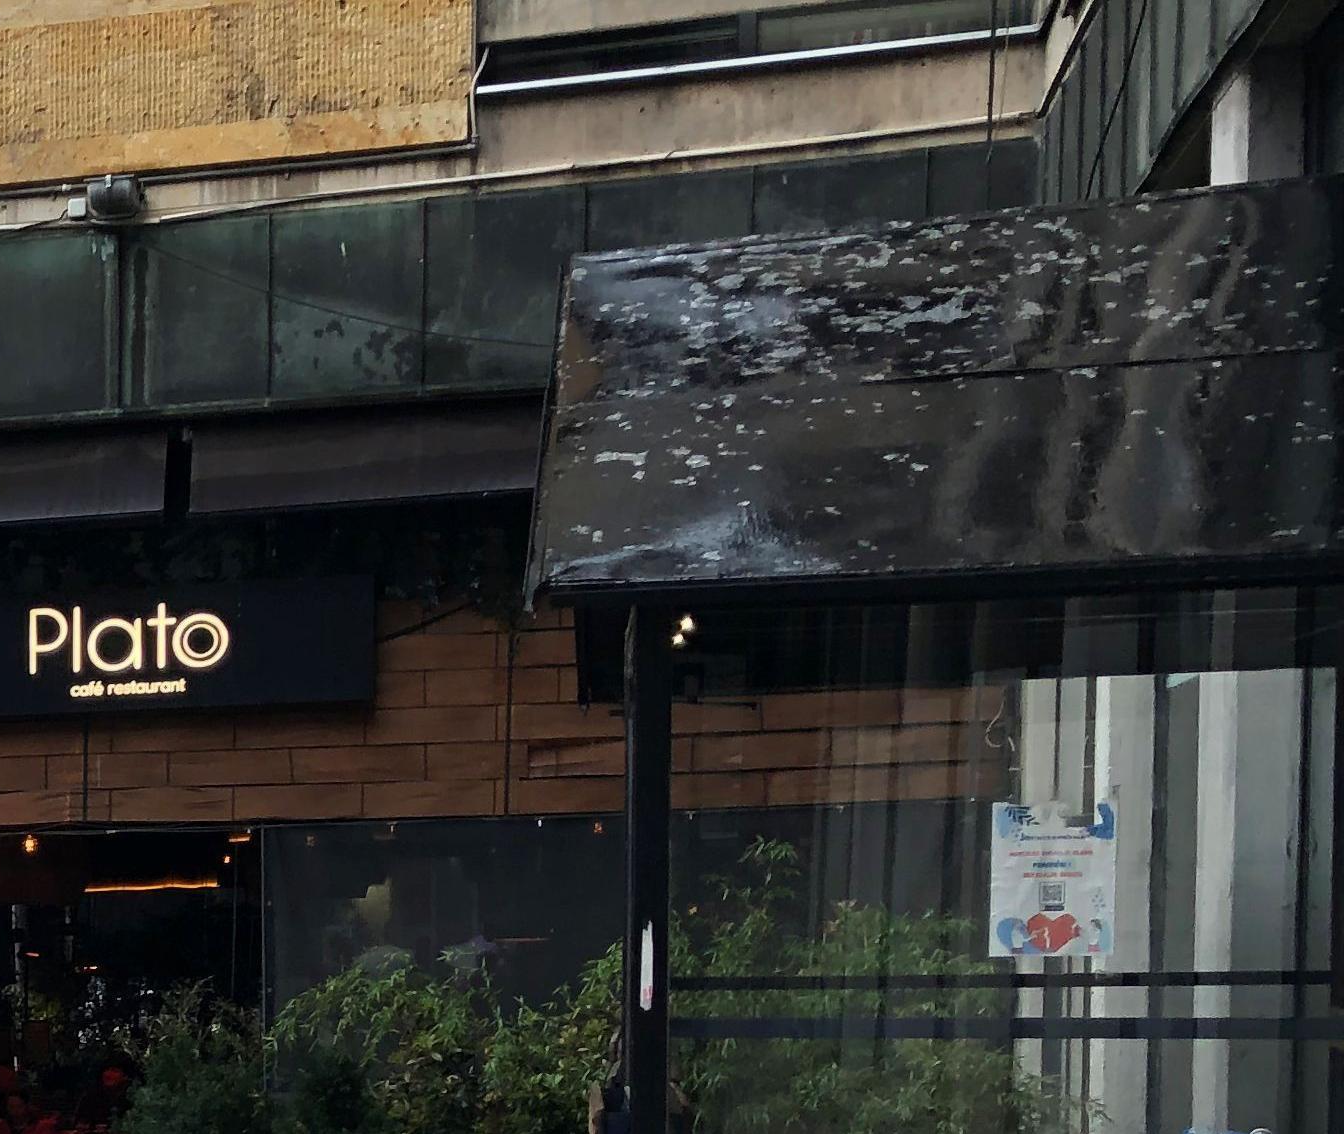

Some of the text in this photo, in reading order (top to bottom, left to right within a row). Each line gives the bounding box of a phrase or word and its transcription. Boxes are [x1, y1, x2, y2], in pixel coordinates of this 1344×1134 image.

[28, 602, 230, 675] Plato
[70, 678, 187, 698] café restaurant
